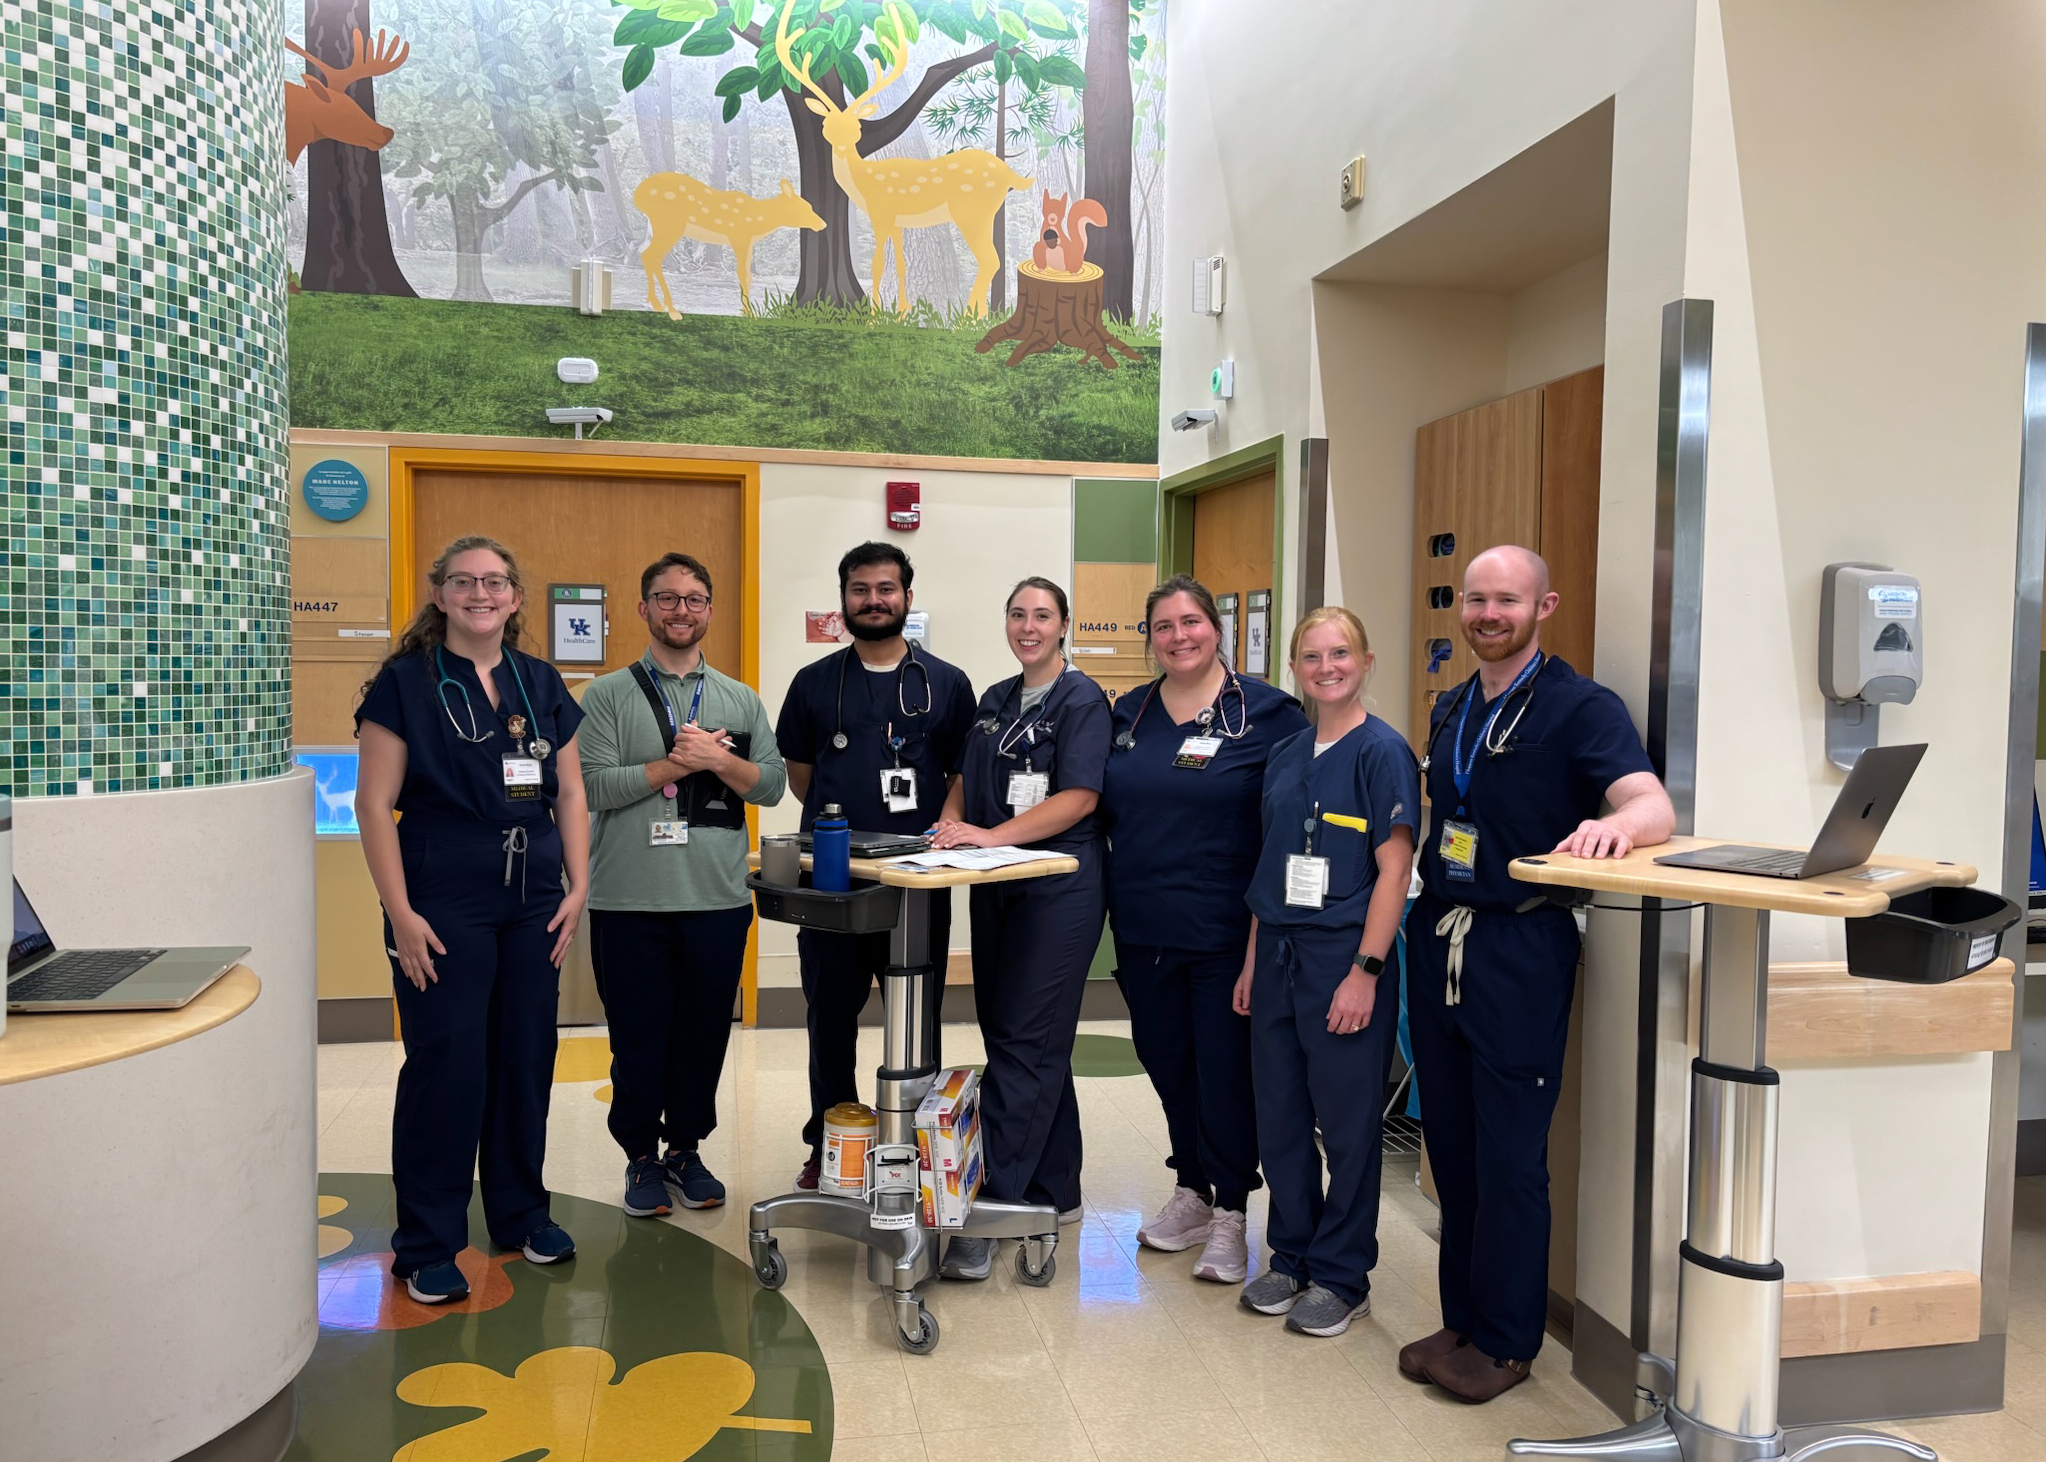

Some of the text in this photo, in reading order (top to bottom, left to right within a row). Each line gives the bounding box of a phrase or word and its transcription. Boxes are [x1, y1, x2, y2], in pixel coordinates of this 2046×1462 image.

[293, 601, 339, 612] HA447
[568, 617, 591, 636] UK
[1079, 622, 1118, 632] HA449
[1448, 870, 1472, 878] PHYSICIAN
[943, 1158, 952, 1167] M
